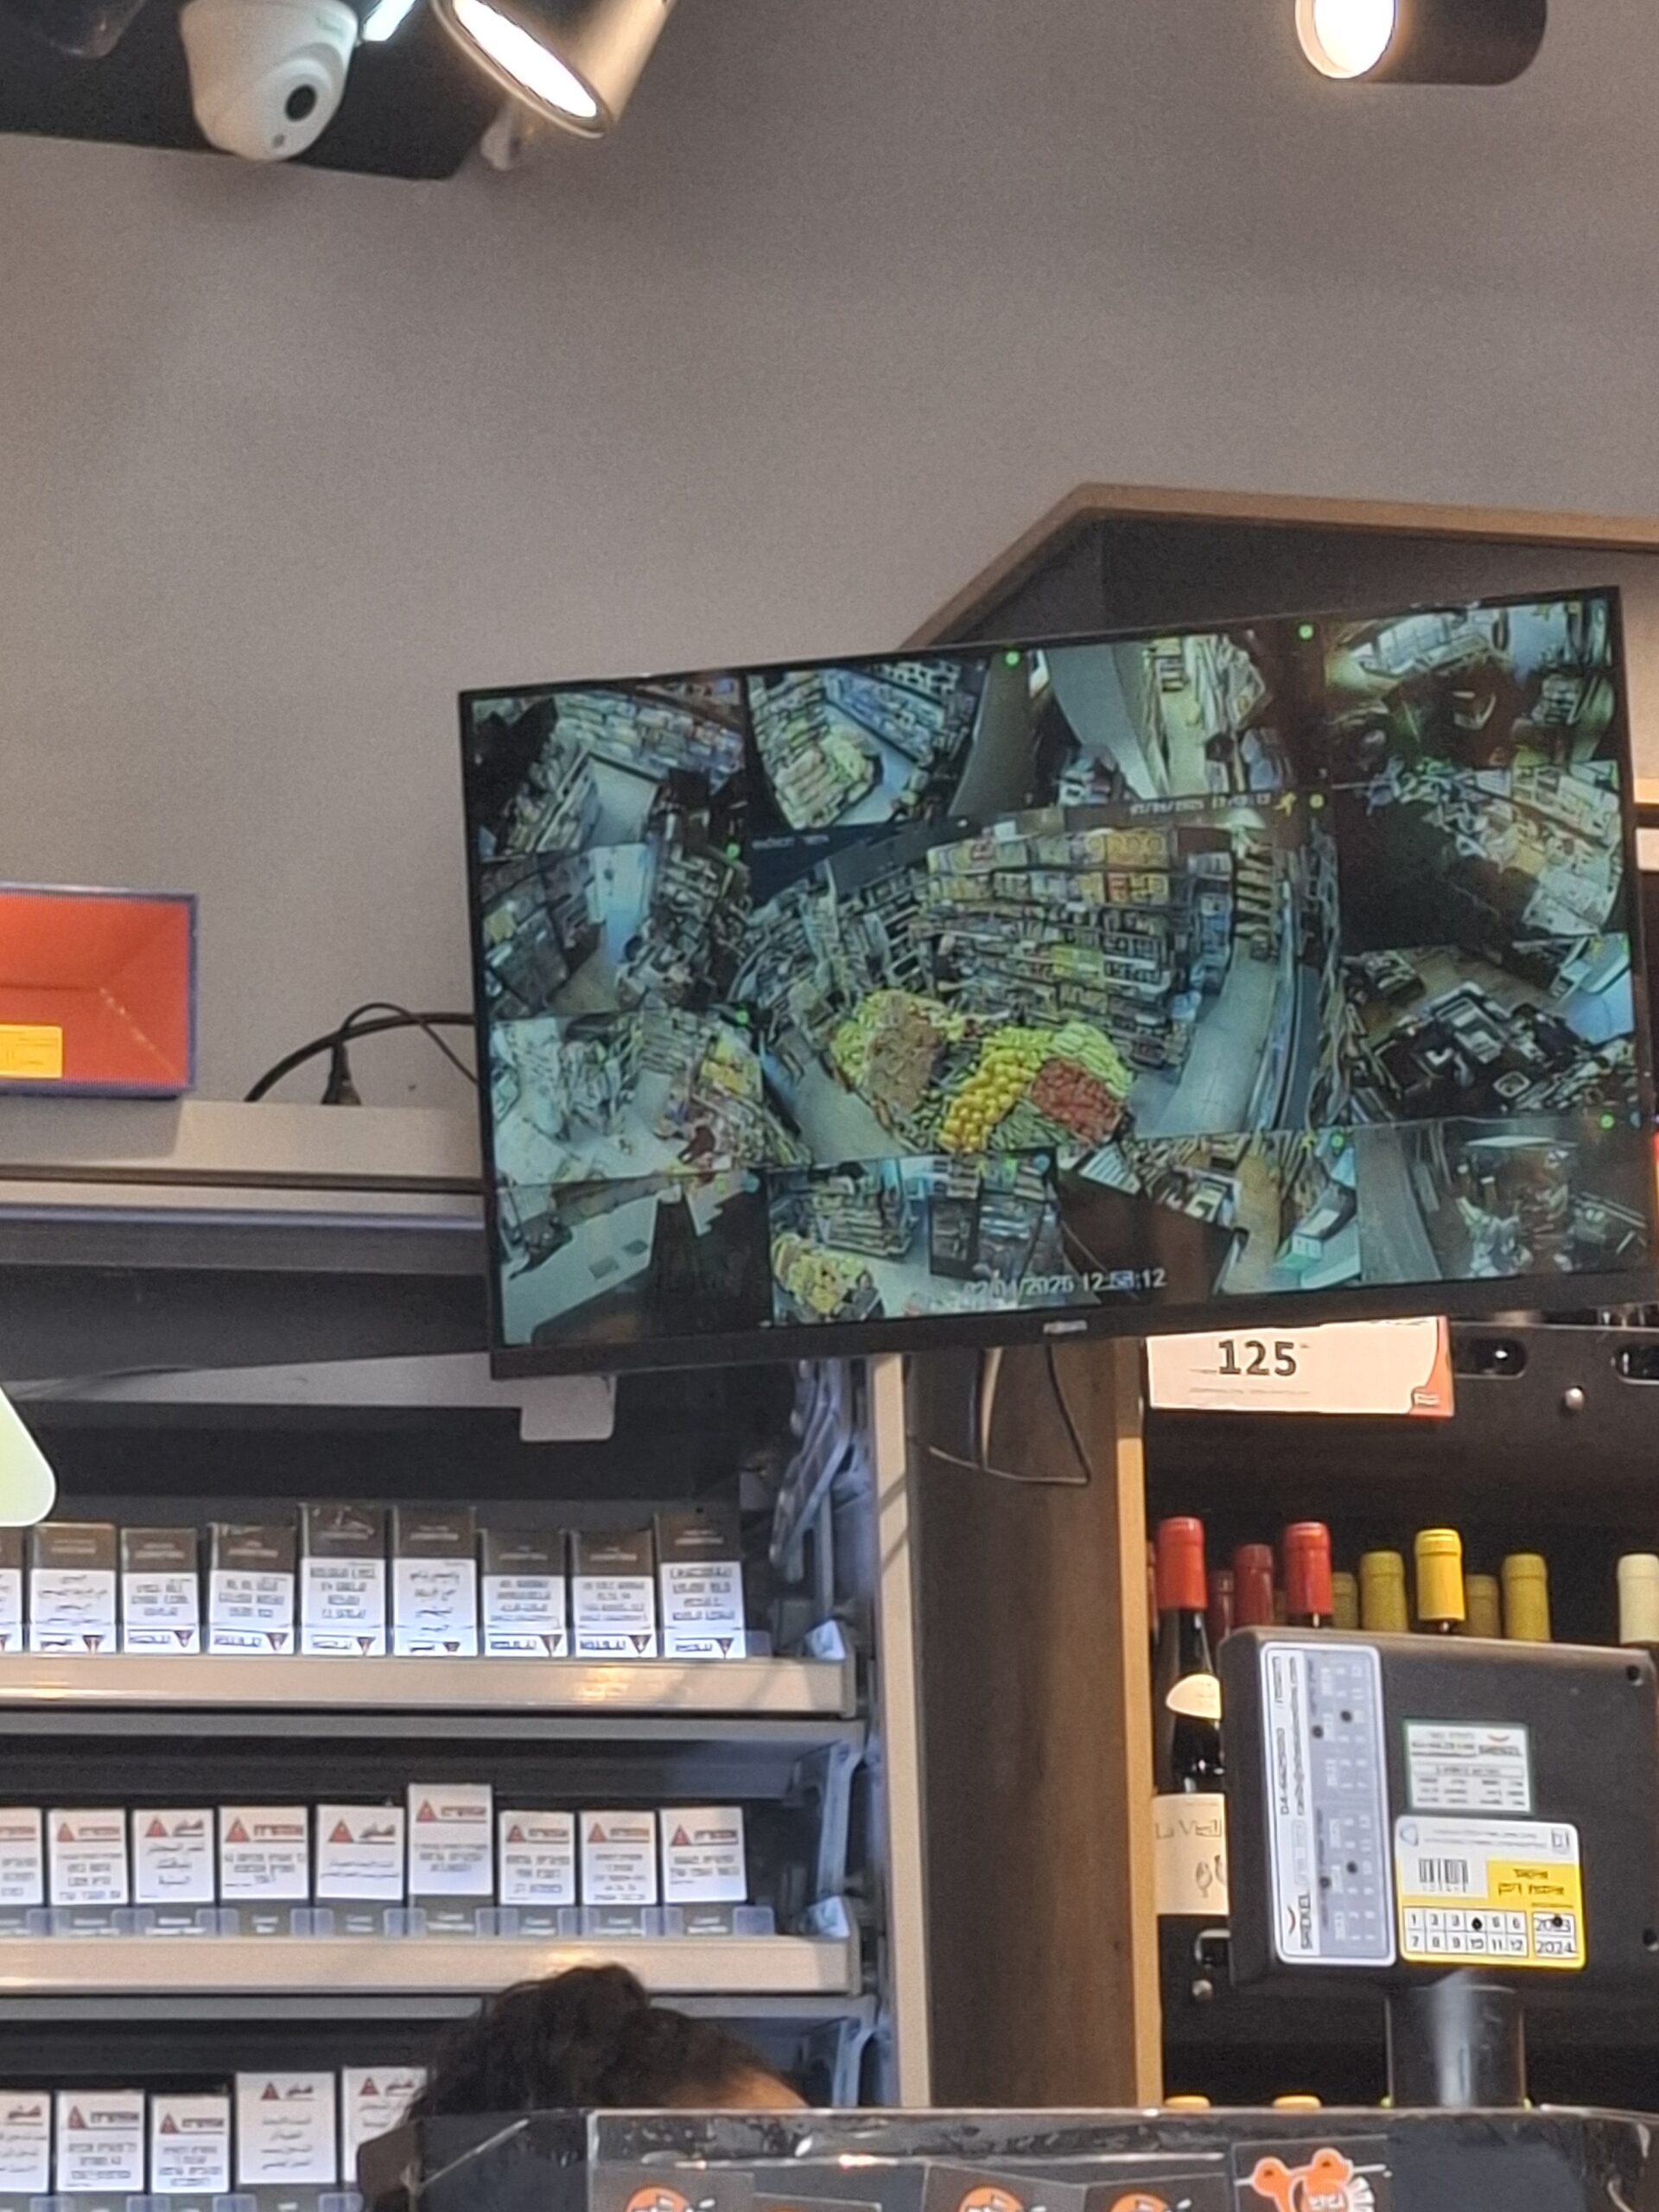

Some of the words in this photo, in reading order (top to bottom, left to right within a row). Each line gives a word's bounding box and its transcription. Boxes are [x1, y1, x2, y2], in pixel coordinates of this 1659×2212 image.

[1217, 1338, 1297, 1376] 125
[1412, 1936, 1419, 1948] 7
[1491, 1938, 1503, 1950] 11
[1536, 1941, 1573, 1954] 2024
